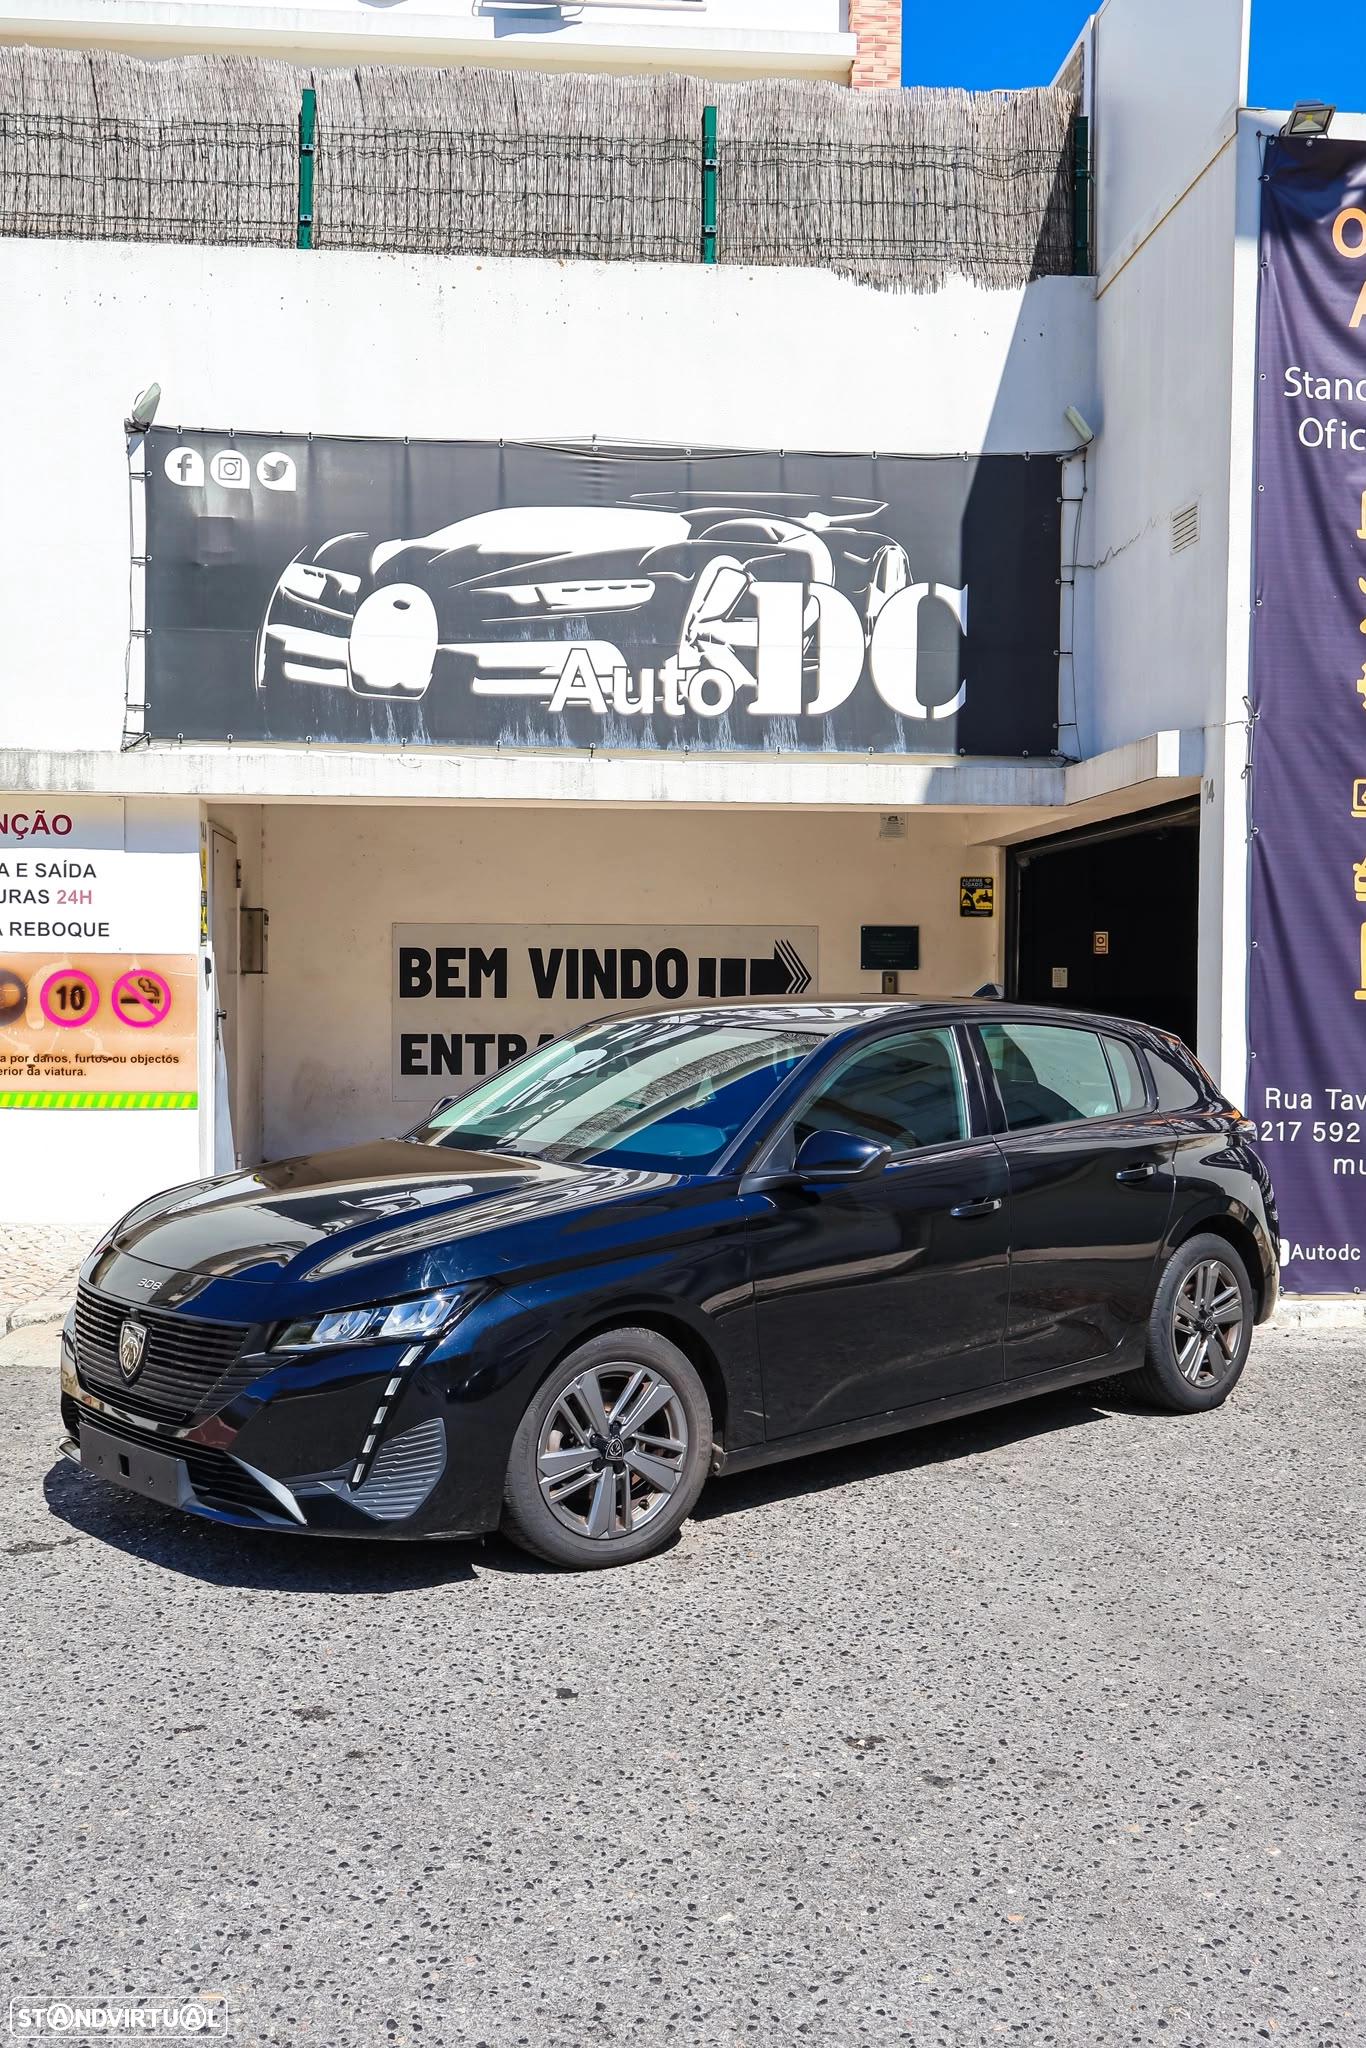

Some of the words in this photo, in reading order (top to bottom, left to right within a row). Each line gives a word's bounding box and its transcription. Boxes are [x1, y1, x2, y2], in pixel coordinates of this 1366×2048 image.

[1298, 417, 1366, 451] Ofic
[548, 647, 736, 717] Auto
[747, 581, 969, 720] DC
[16, 862, 28, 878] E
[35, 859, 97, 879] SAÍDA
[56, 889, 92, 905] 24H
[9, 921, 110, 938] REBOQUE
[400, 947, 508, 998] BEM
[528, 947, 689, 999] VINDO
[55, 985, 86, 1011] 10
[10, 1055, 30, 1065] por
[32, 1053, 71, 1064] danos,
[75, 1053, 109, 1064] furtos
[112, 1056, 127, 1064] ou
[130, 1054, 180, 1066] objectos
[27, 1065, 41, 1076] da
[44, 1067, 87, 1076] viatura.
[1265, 1087, 1312, 1110] Rua
[1324, 1088, 1366, 1111] Tav
[1260, 1120, 1303, 1142] 217
[1312, 1121, 1361, 1143] 592
[1290, 1243, 1361, 1261] Autodc
